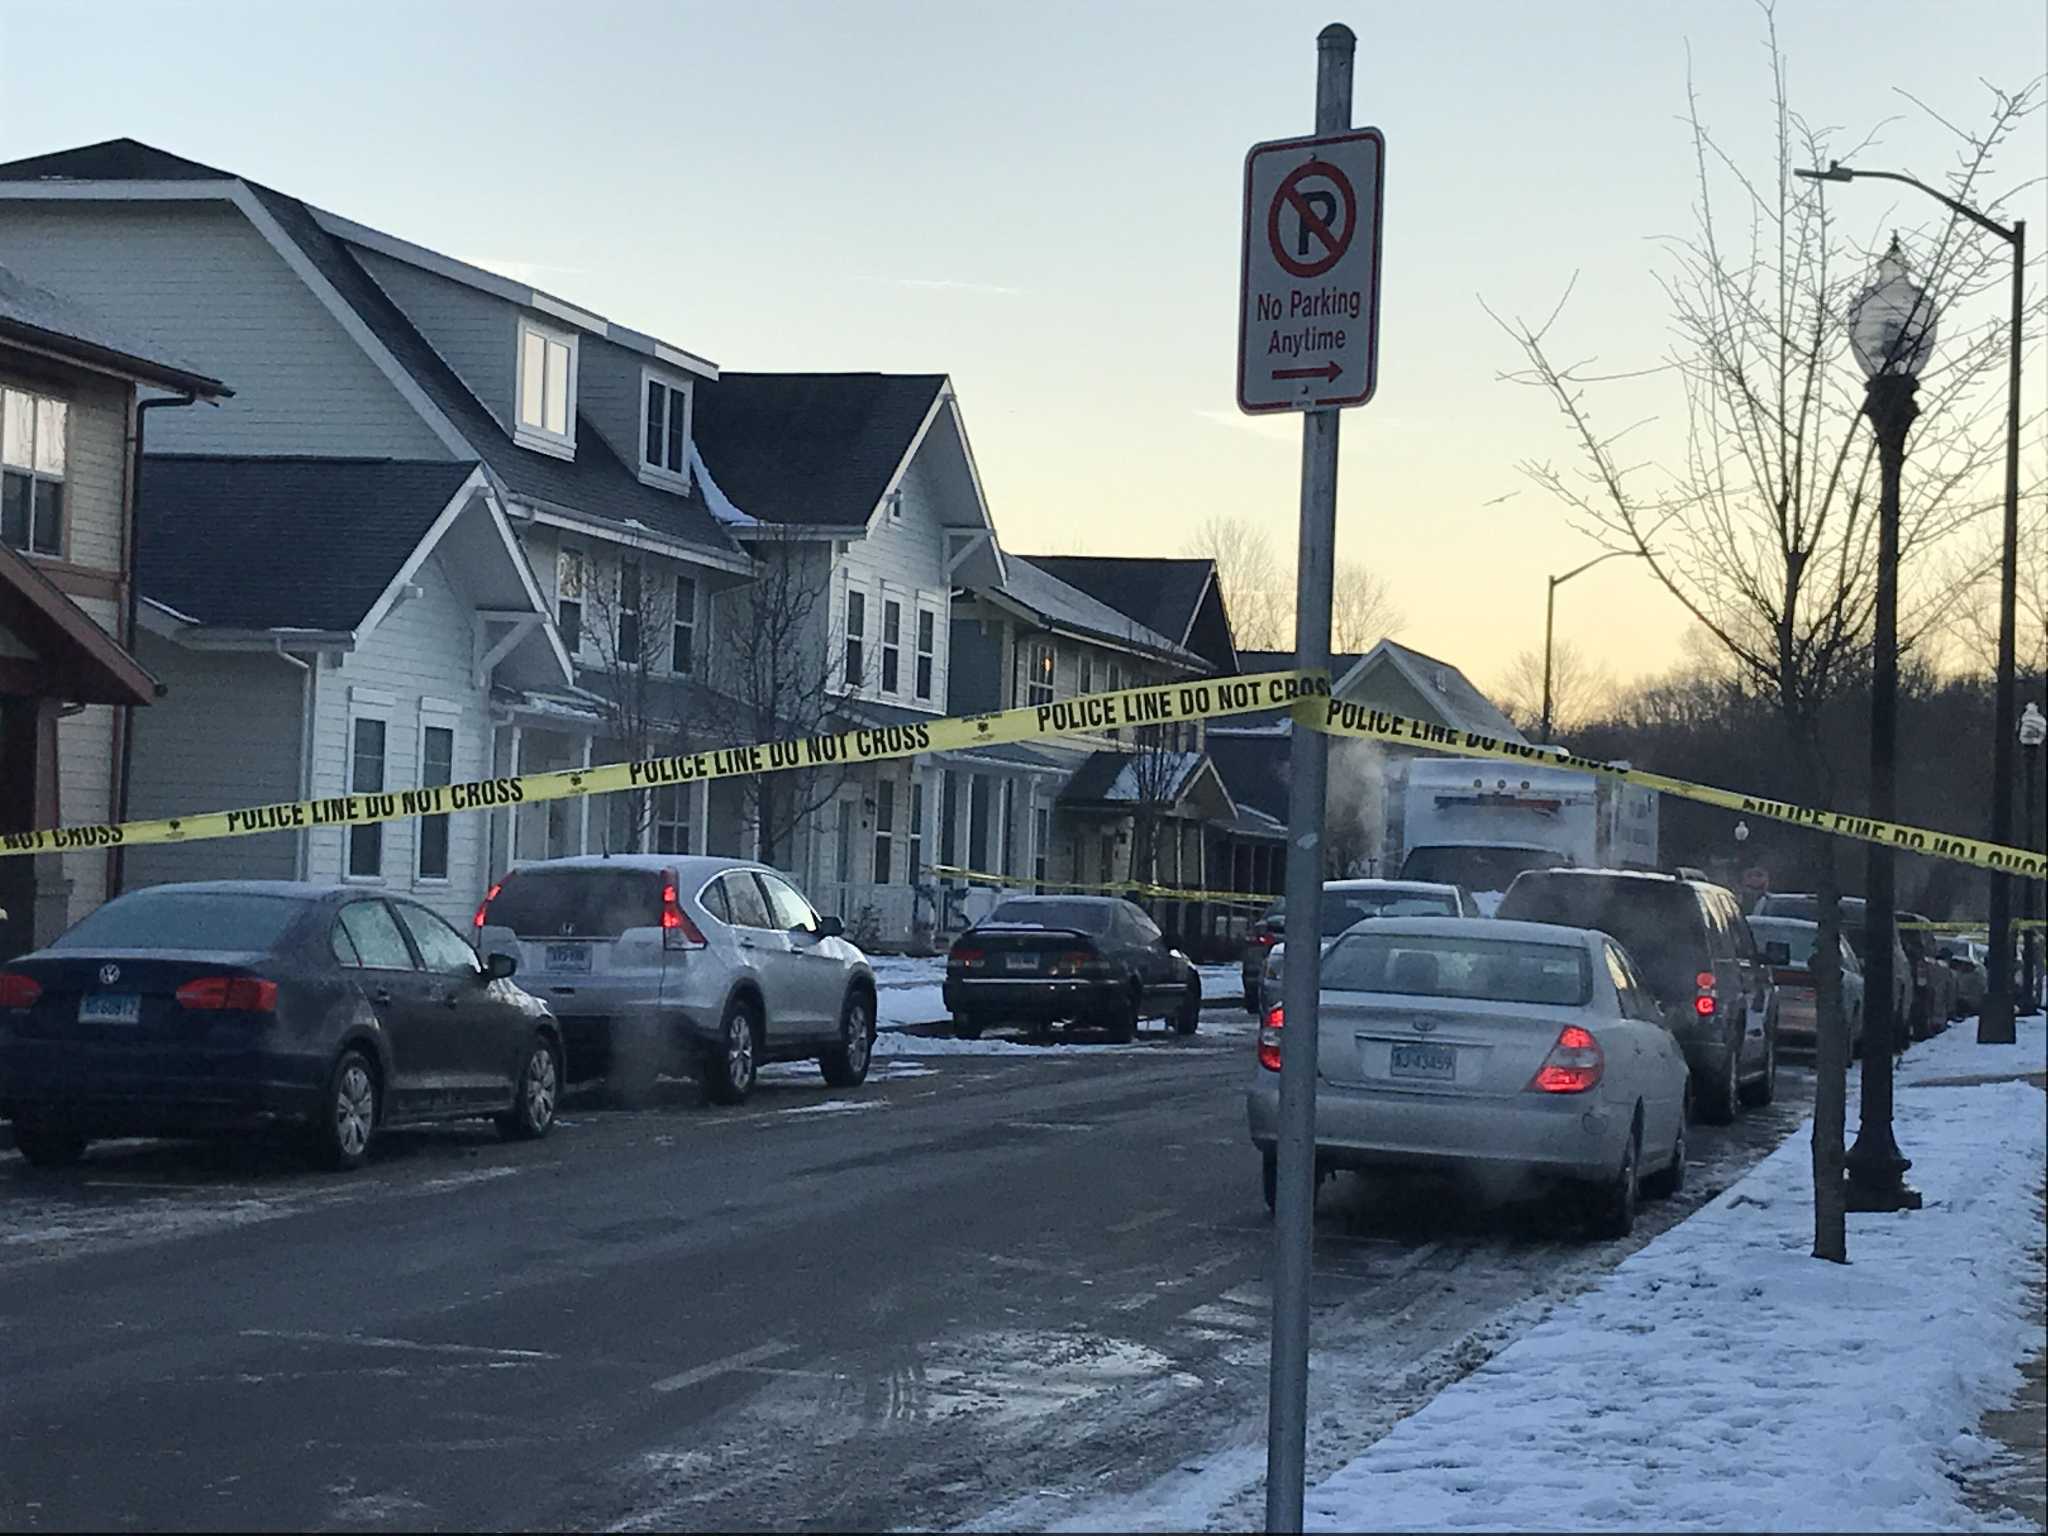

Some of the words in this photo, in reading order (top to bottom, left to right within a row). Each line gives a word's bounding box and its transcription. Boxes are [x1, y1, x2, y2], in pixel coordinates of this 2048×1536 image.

[1257, 292, 1282, 321] No
[1290, 286, 1360, 319] Parking
[1267, 326, 1346, 358] Anytime
[1037, 697, 1117, 732] POLICE
[1123, 691, 1172, 723] LINE
[1180, 687, 1210, 715] DO
[1217, 682, 1261, 710] NOT
[1326, 699, 1405, 736] POLICE
[1410, 720, 1459, 745] LINE
[629, 755, 707, 785] POLICE
[713, 747, 762, 774] LINE
[769, 740, 799, 767] DO
[806, 734, 849, 763] NOT
[856, 723, 930, 757] CROSS
[226, 805, 304, 832] POLICE
[311, 797, 359, 823] LINE
[365, 795, 395, 818] DO
[402, 788, 441, 814] NOT
[451, 777, 524, 809] CROSS
[4, 831, 43, 850] NOT
[52, 825, 123, 847] CROSS
